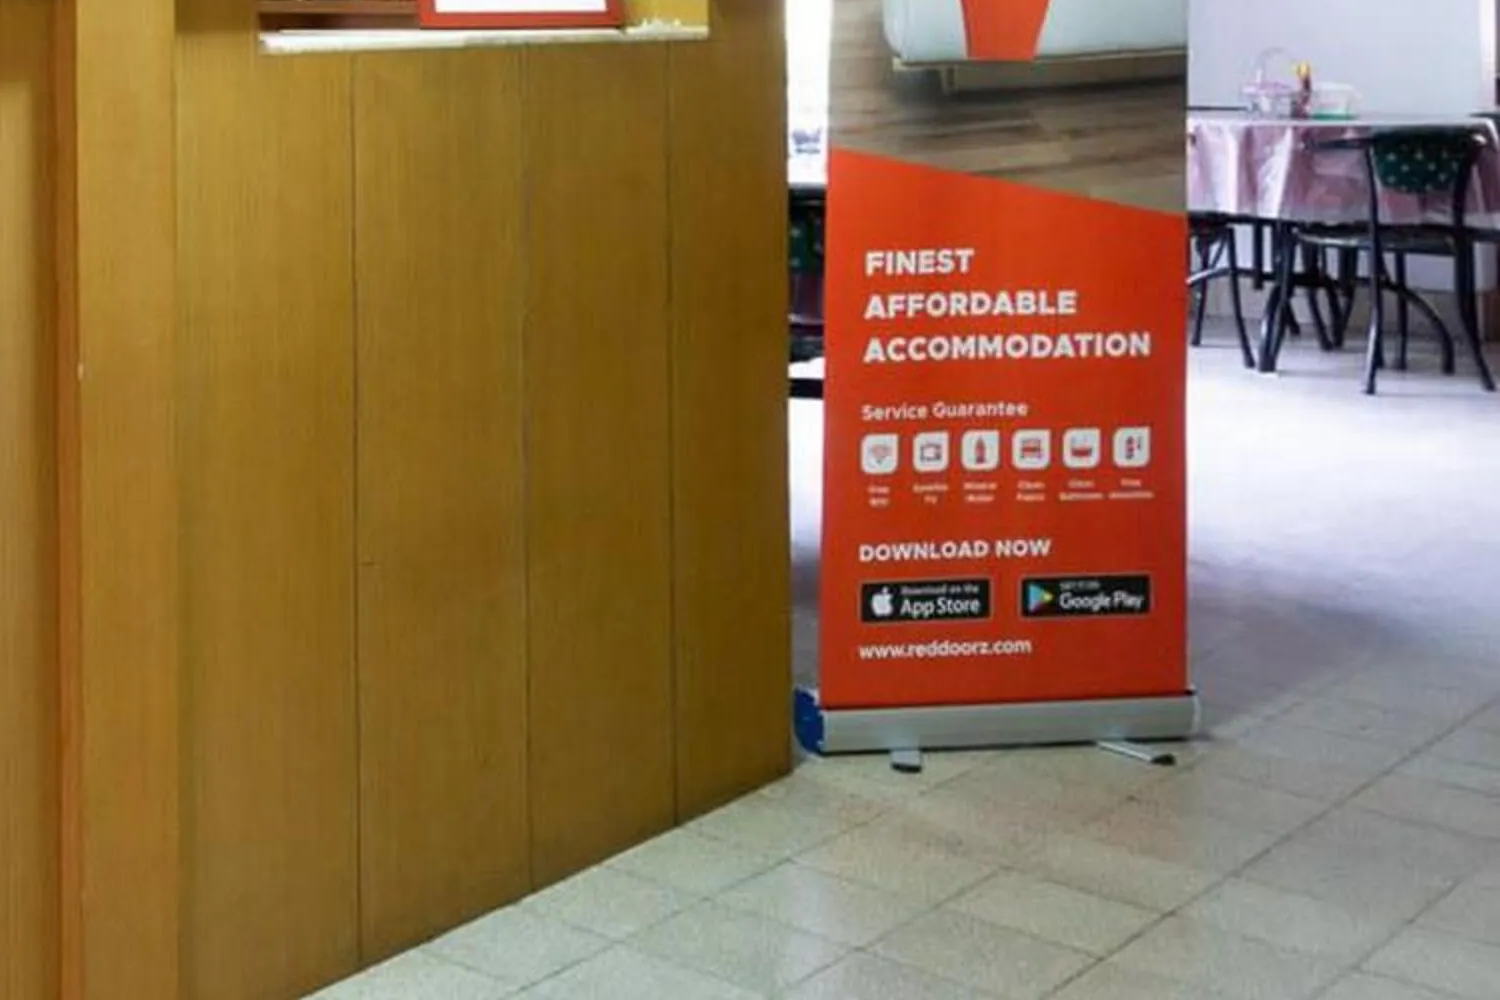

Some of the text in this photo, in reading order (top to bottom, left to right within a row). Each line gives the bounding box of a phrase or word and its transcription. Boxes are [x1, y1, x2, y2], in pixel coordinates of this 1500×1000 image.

[865, 248, 975, 276] FINEST
[864, 290, 1077, 320] AFFORDABLE
[863, 332, 1151, 363] ACCOMMODATION
[861, 401, 1029, 421] Service Guarantee
[859, 538, 1052, 562] DOWNLOAD NOW
[900, 597, 981, 619] App Store
[1059, 590, 1145, 612] Google Play
[859, 639, 1032, 660] www.reddoorz.com
